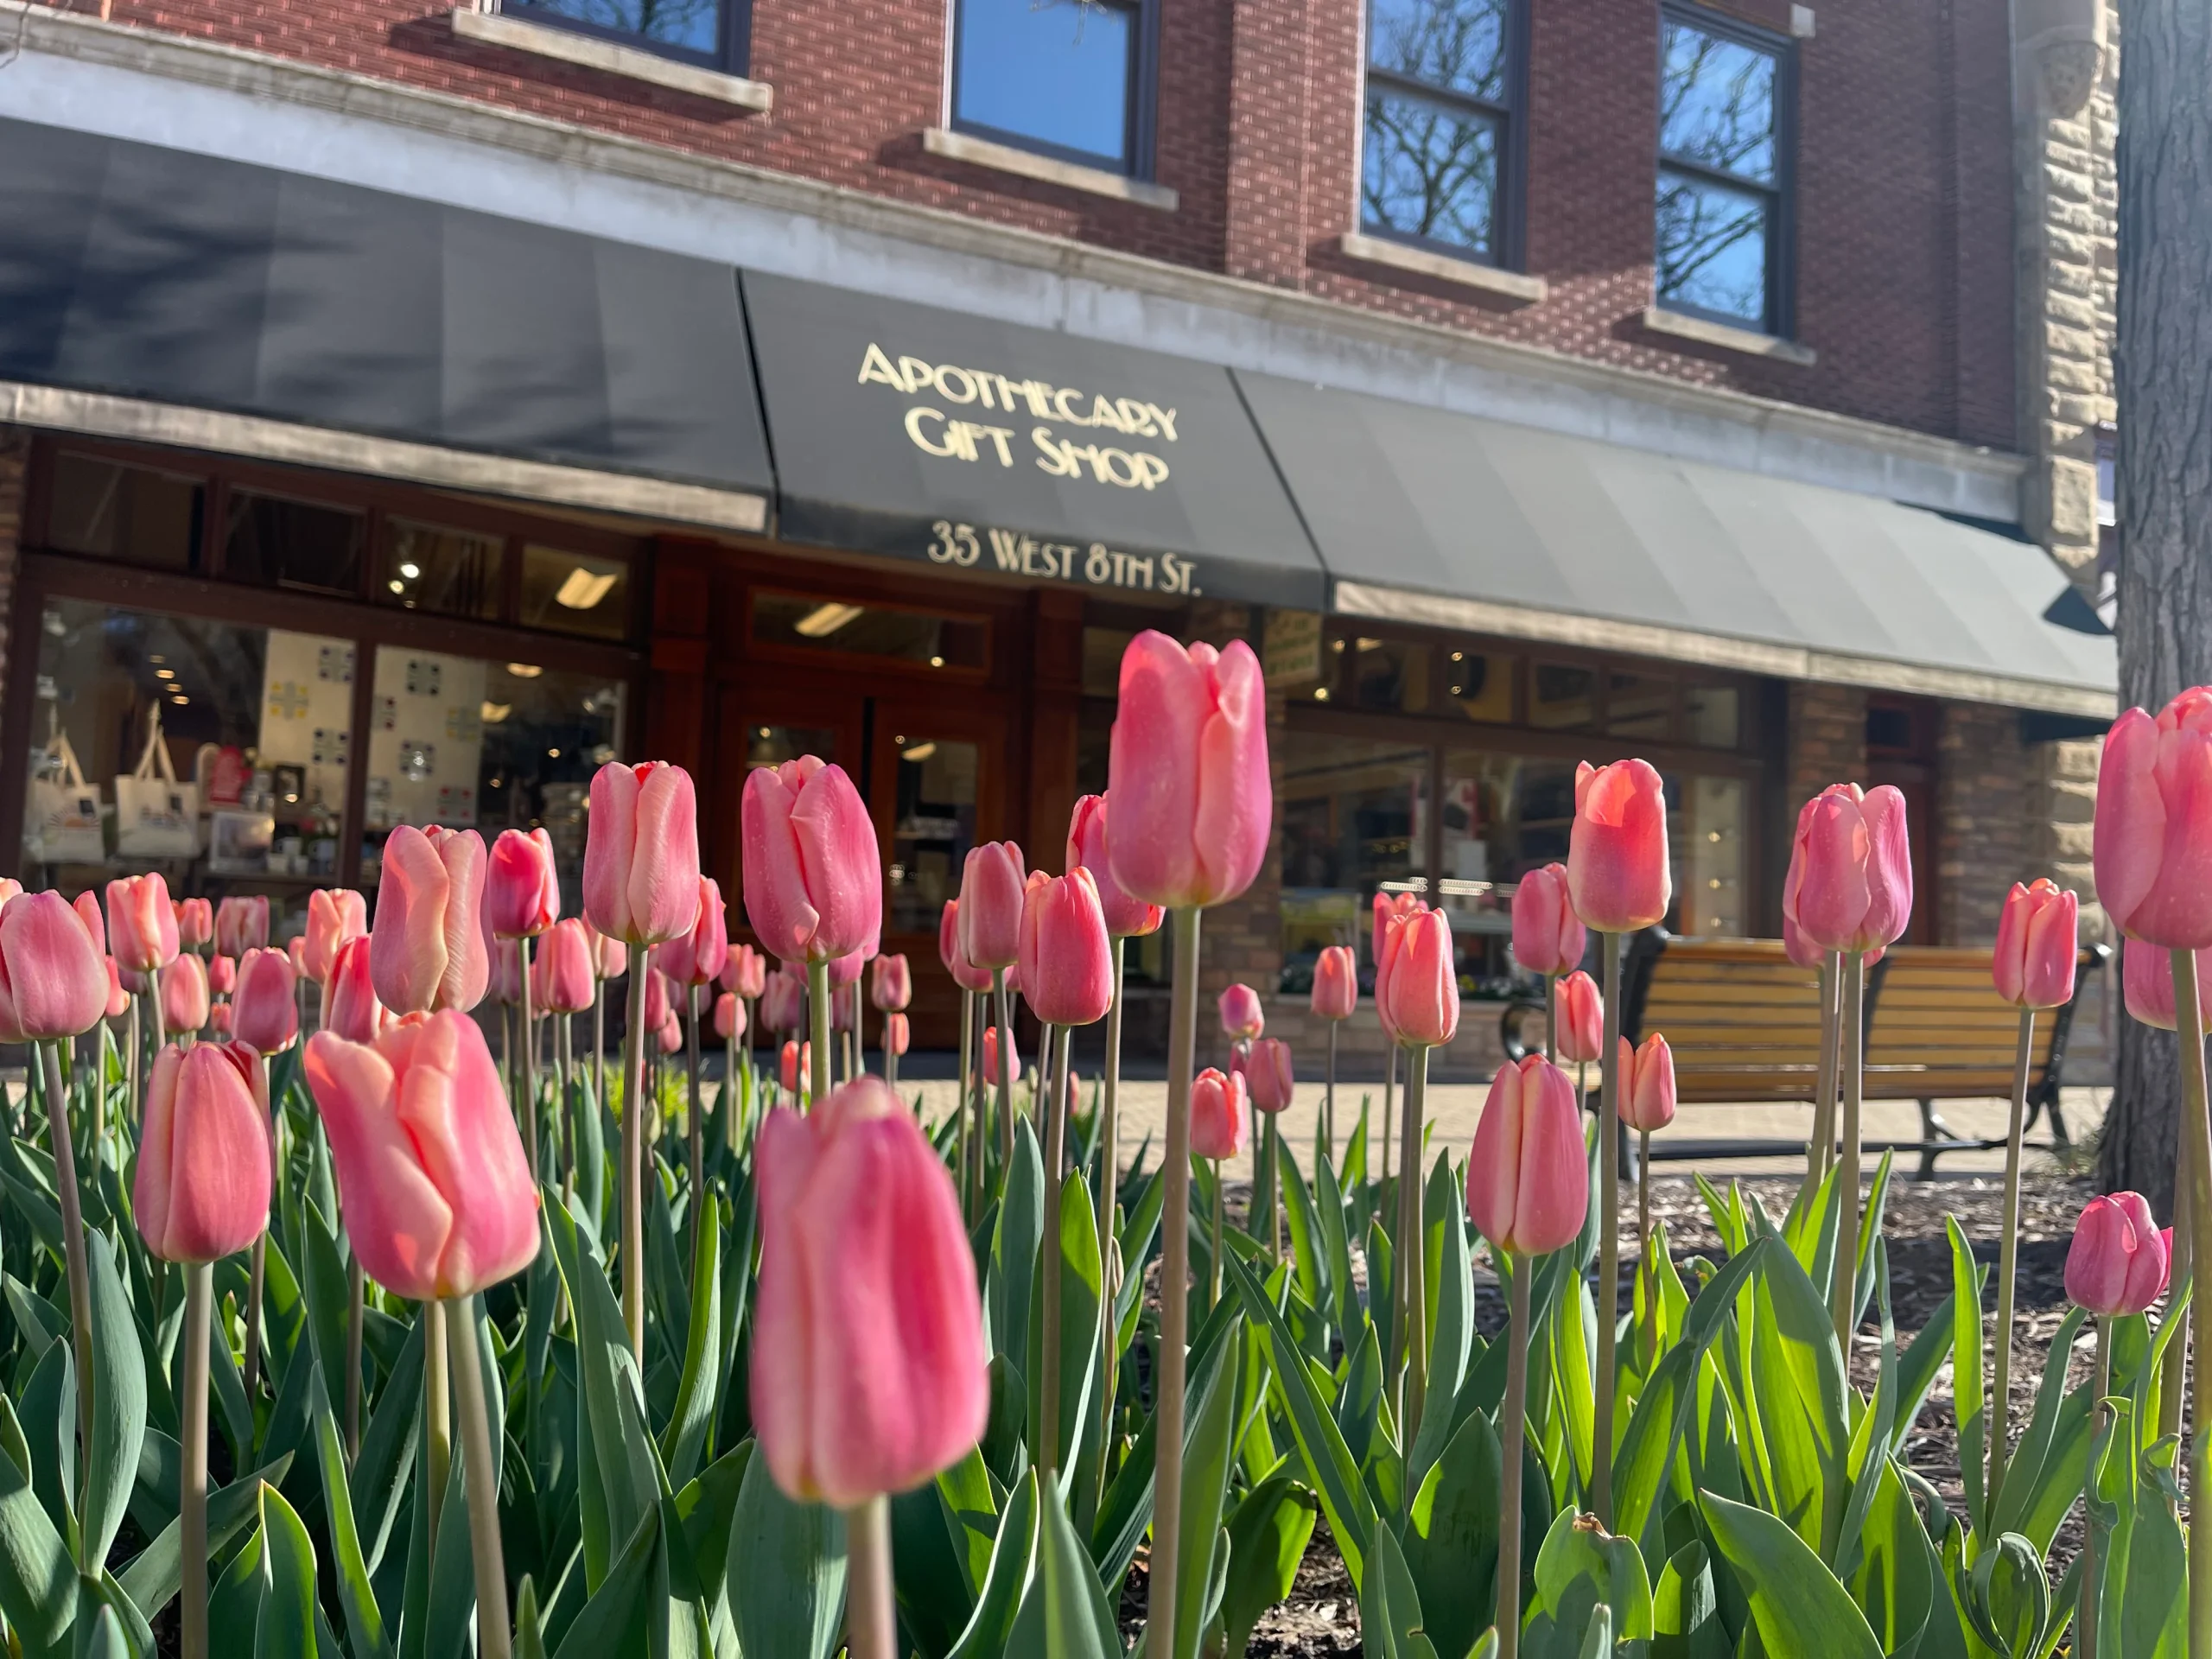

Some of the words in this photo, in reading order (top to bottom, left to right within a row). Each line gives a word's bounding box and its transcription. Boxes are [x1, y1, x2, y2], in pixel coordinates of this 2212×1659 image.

[858, 342, 1178, 442] APOTHECARY
[905, 406, 1014, 467] GIFT
[1032, 426, 1169, 491] SHOP
[927, 520, 981, 566] 35
[988, 528, 1078, 580] WEST
[1085, 542, 1154, 590] 8TH
[1159, 552, 1202, 597] ST.
